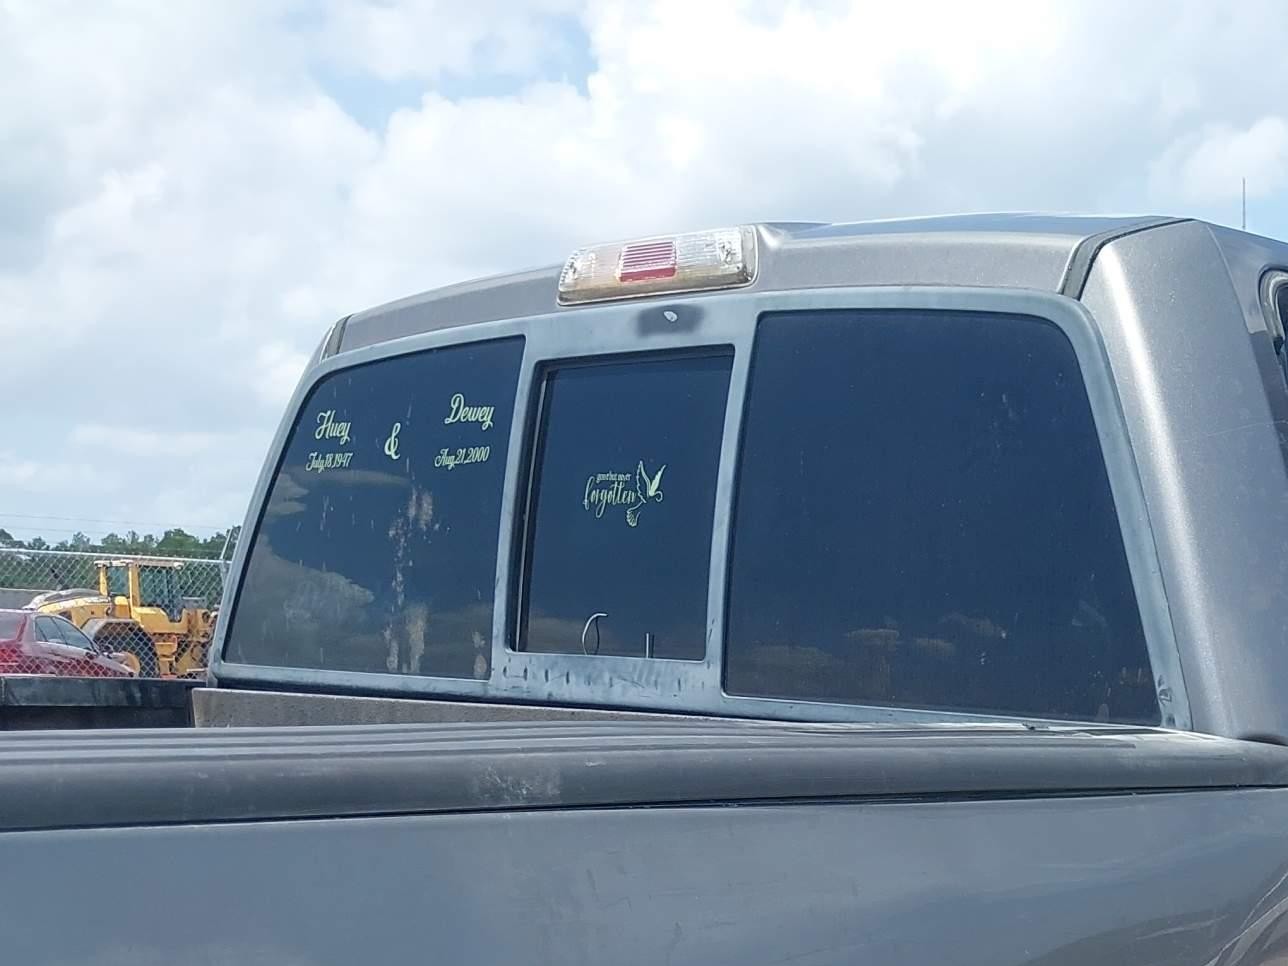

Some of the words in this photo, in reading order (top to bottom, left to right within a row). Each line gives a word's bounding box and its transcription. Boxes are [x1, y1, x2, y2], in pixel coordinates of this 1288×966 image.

[315, 410, 351, 444] Huey
[444, 393, 495, 430] Dewey
[384, 422, 402, 460] &
[583, 476, 636, 518] forgotten
